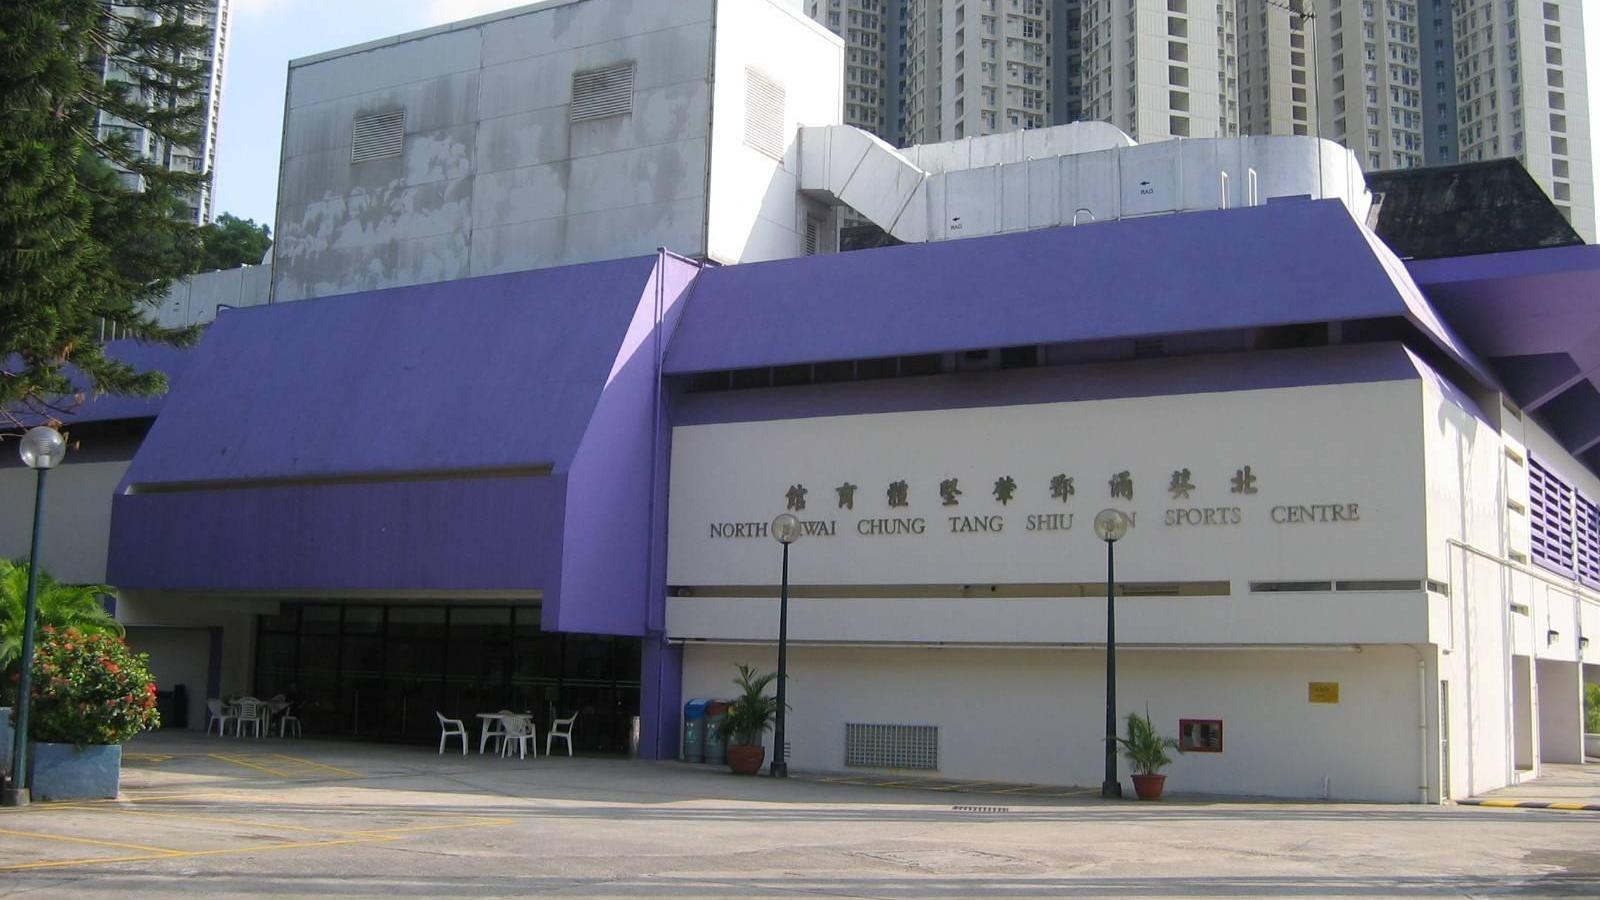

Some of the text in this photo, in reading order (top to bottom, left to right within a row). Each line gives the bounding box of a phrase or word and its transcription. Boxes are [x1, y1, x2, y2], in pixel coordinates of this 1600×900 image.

[710, 503, 1360, 539] NORTH WAI CHUNG TANG SHIU SPORTS CENTRE
